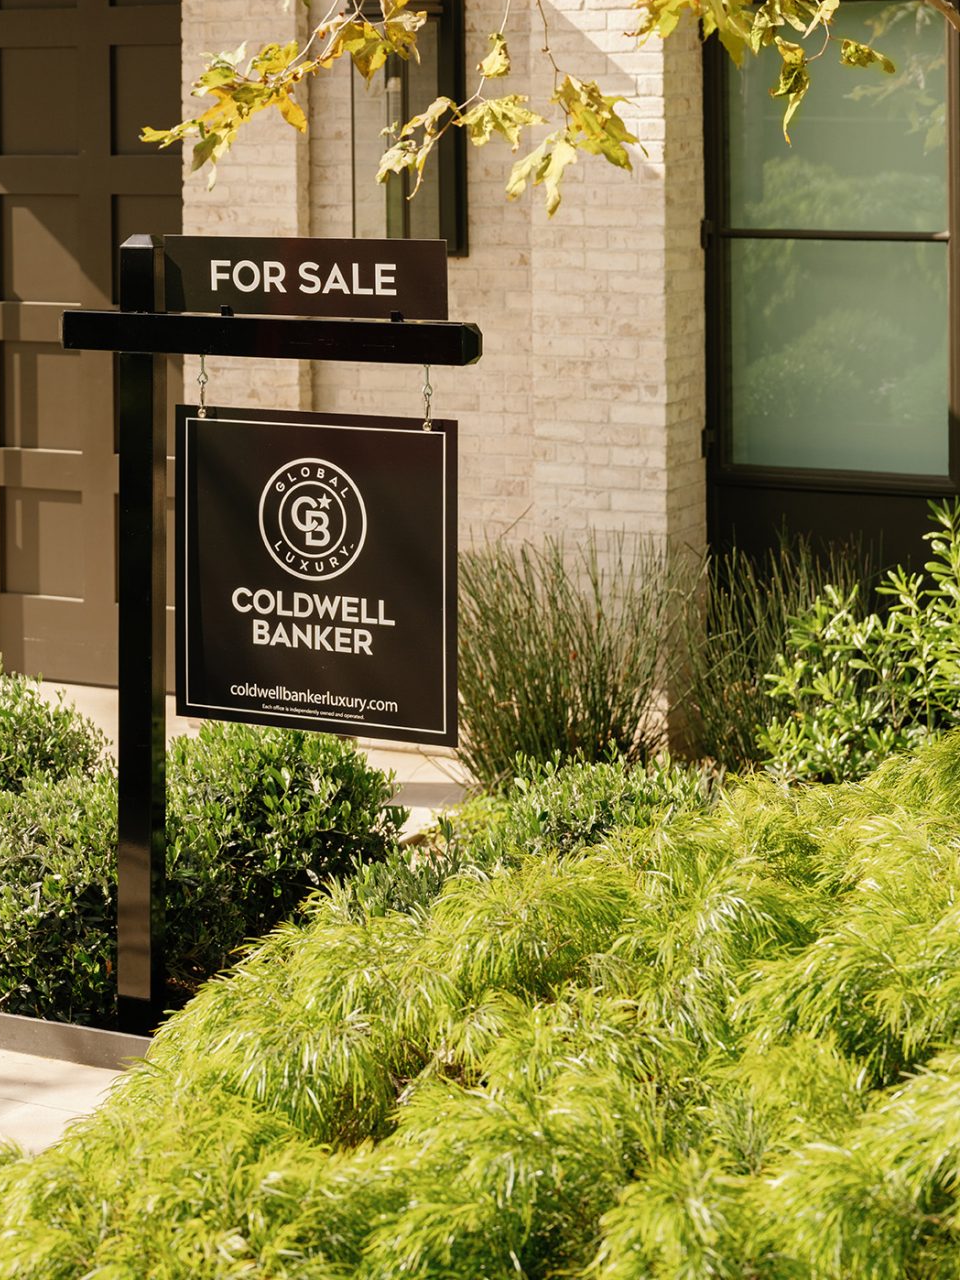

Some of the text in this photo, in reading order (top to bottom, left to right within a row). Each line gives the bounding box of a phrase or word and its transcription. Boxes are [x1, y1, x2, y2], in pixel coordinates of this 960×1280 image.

[210, 259, 398, 296] FOR SALE
[275, 466, 349, 499] GLOBAL
[274, 540, 349, 572] LUXURY
[231, 586, 396, 627] COLDWELL
[252, 618, 374, 656] BANKER
[230, 682, 398, 713] coldwellbankerluxury.com
[289, 706, 320, 715] independently
